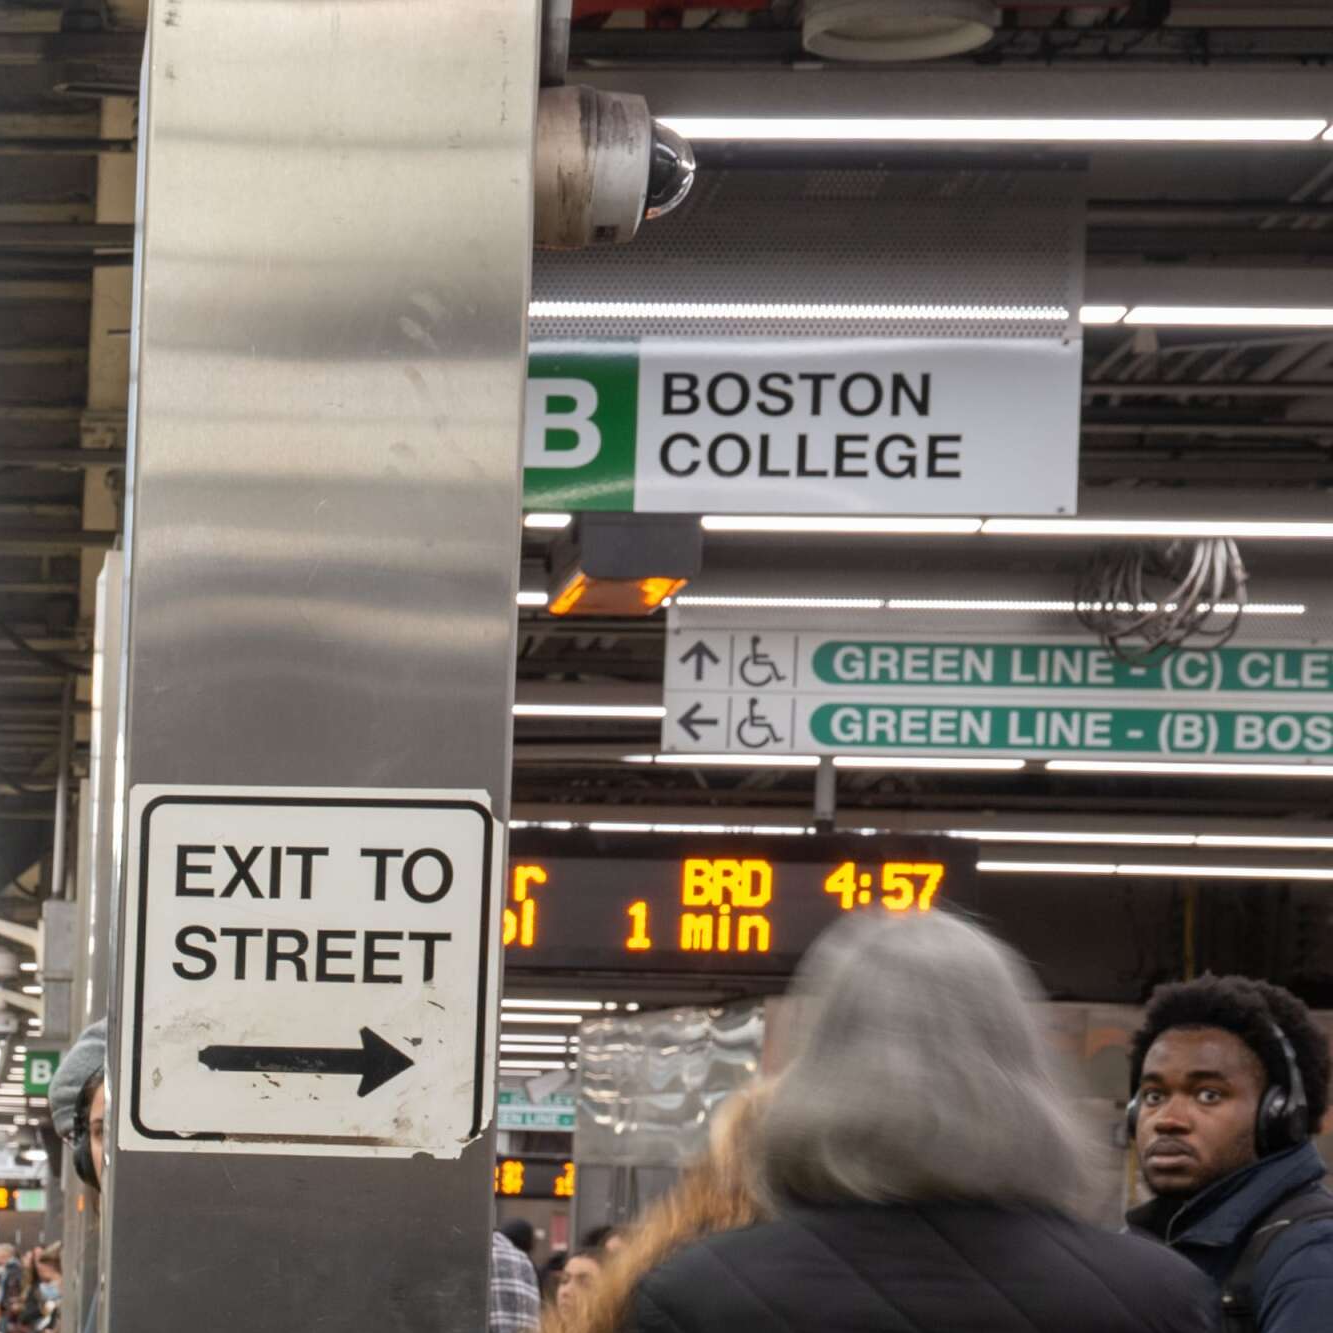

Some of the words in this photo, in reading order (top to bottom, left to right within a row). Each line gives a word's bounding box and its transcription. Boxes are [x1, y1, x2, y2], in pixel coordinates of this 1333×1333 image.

[662, 372, 932, 418] BOSTON
[523, 377, 602, 469] B
[659, 432, 963, 479] COLLEGE
[832, 646, 994, 682] GREEN
[1010, 649, 1115, 684] LINE
[1129, 666, 1147, 676] -
[1160, 651, 1224, 691] (C)
[1238, 652, 1333, 689] CLE
[830, 708, 993, 745] GREEN
[1007, 711, 1113, 748] LINE
[1126, 729, 1144, 740] -
[1157, 712, 1220, 755] (B)
[1234, 715, 1333, 753] BOS
[175, 844, 329, 900] EXIT
[360, 847, 454, 904] TO
[683, 858, 773, 907] BRD
[824, 862, 945, 911] 4:57
[625, 901, 652, 950] 1
[679, 904, 771, 951] min
[172, 925, 452, 985] STREET
[30, 1059, 52, 1085] B
